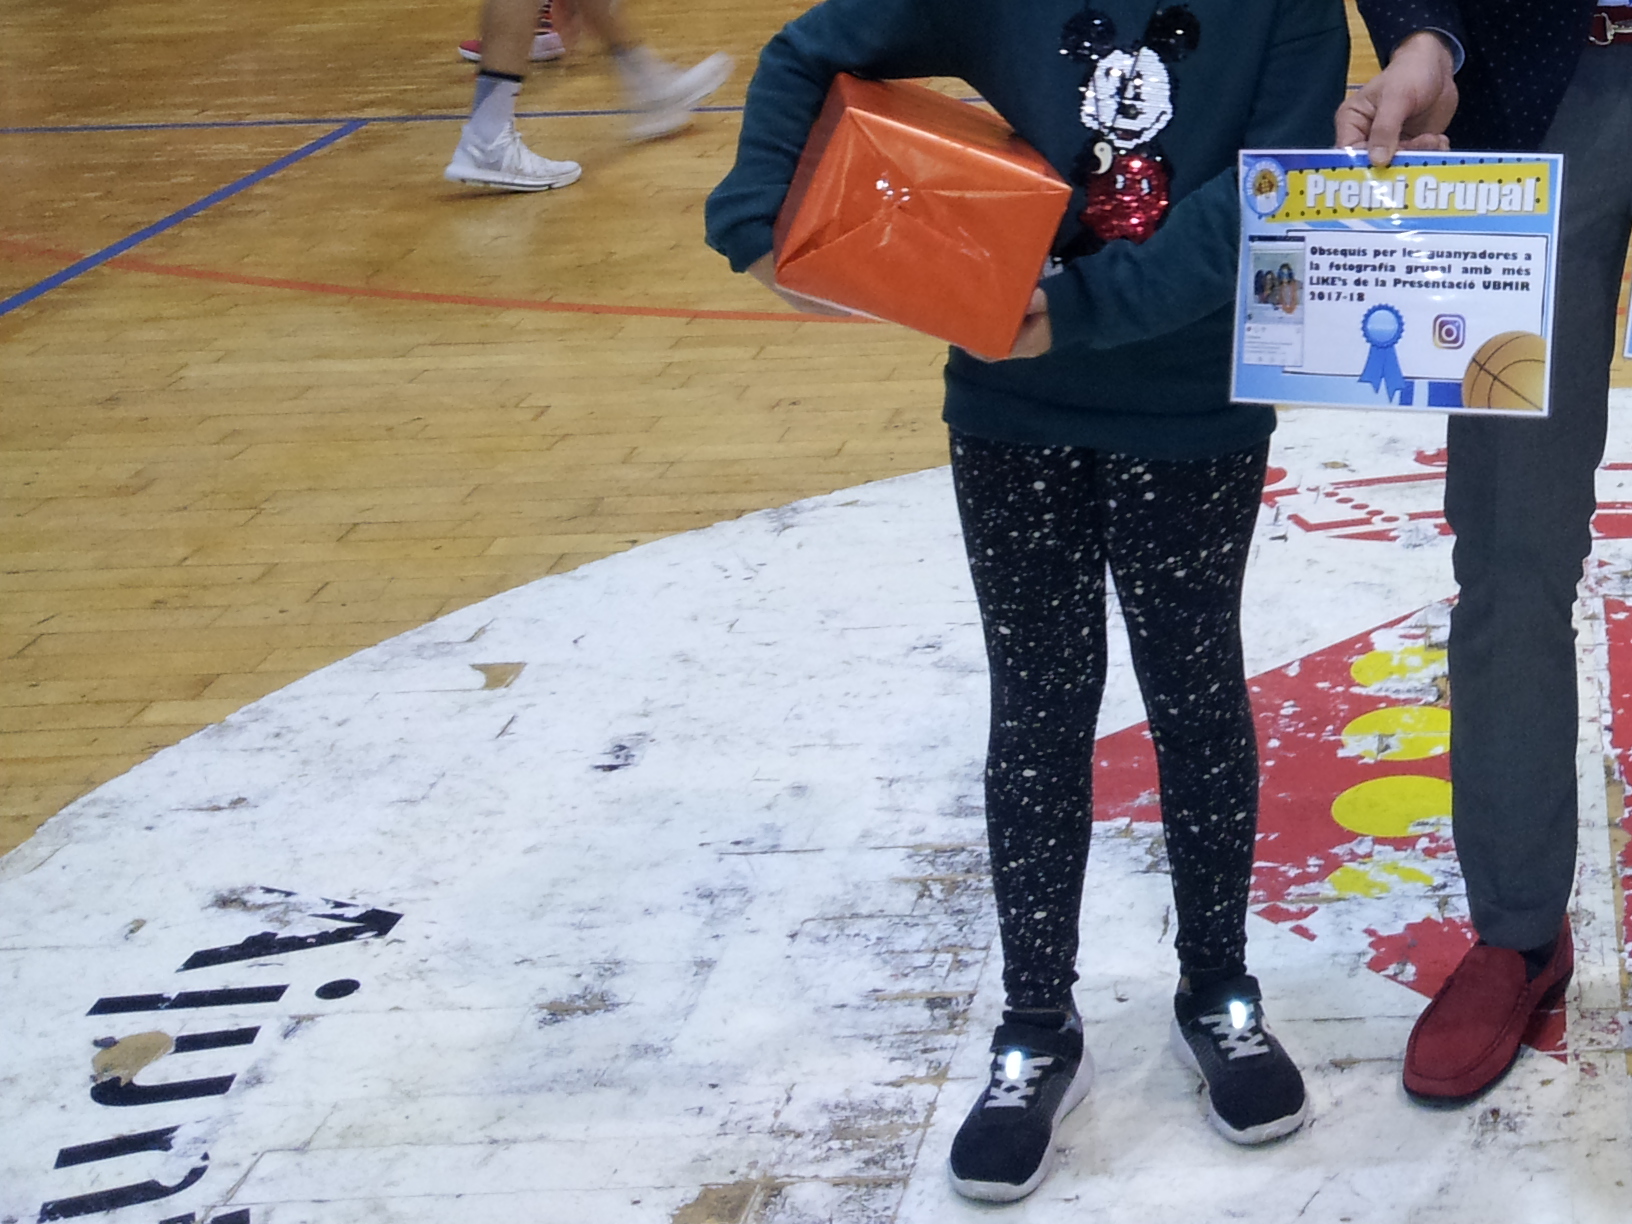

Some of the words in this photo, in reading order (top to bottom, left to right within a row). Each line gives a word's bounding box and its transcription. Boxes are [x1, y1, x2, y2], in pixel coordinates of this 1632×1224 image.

[1306, 174, 1407, 210] Premi
[1414, 175, 1537, 215] Grupal
[1309, 246, 1368, 258] Obsequis
[1373, 248, 1397, 259] per
[1427, 249, 1519, 262] guanyadores
[1524, 252, 1533, 261] a
[1309, 261, 1320, 272] la
[1405, 263, 1452, 275] grupal
[1461, 265, 1493, 275] amb
[1309, 276, 1348, 287] LIKE's
[1353, 277, 1369, 288] de
[1375, 277, 1387, 288] la
[1393, 278, 1476, 291] Presentació
[1482, 280, 1531, 292] UBMIR
[1309, 292, 1366, 303] 2017-18
